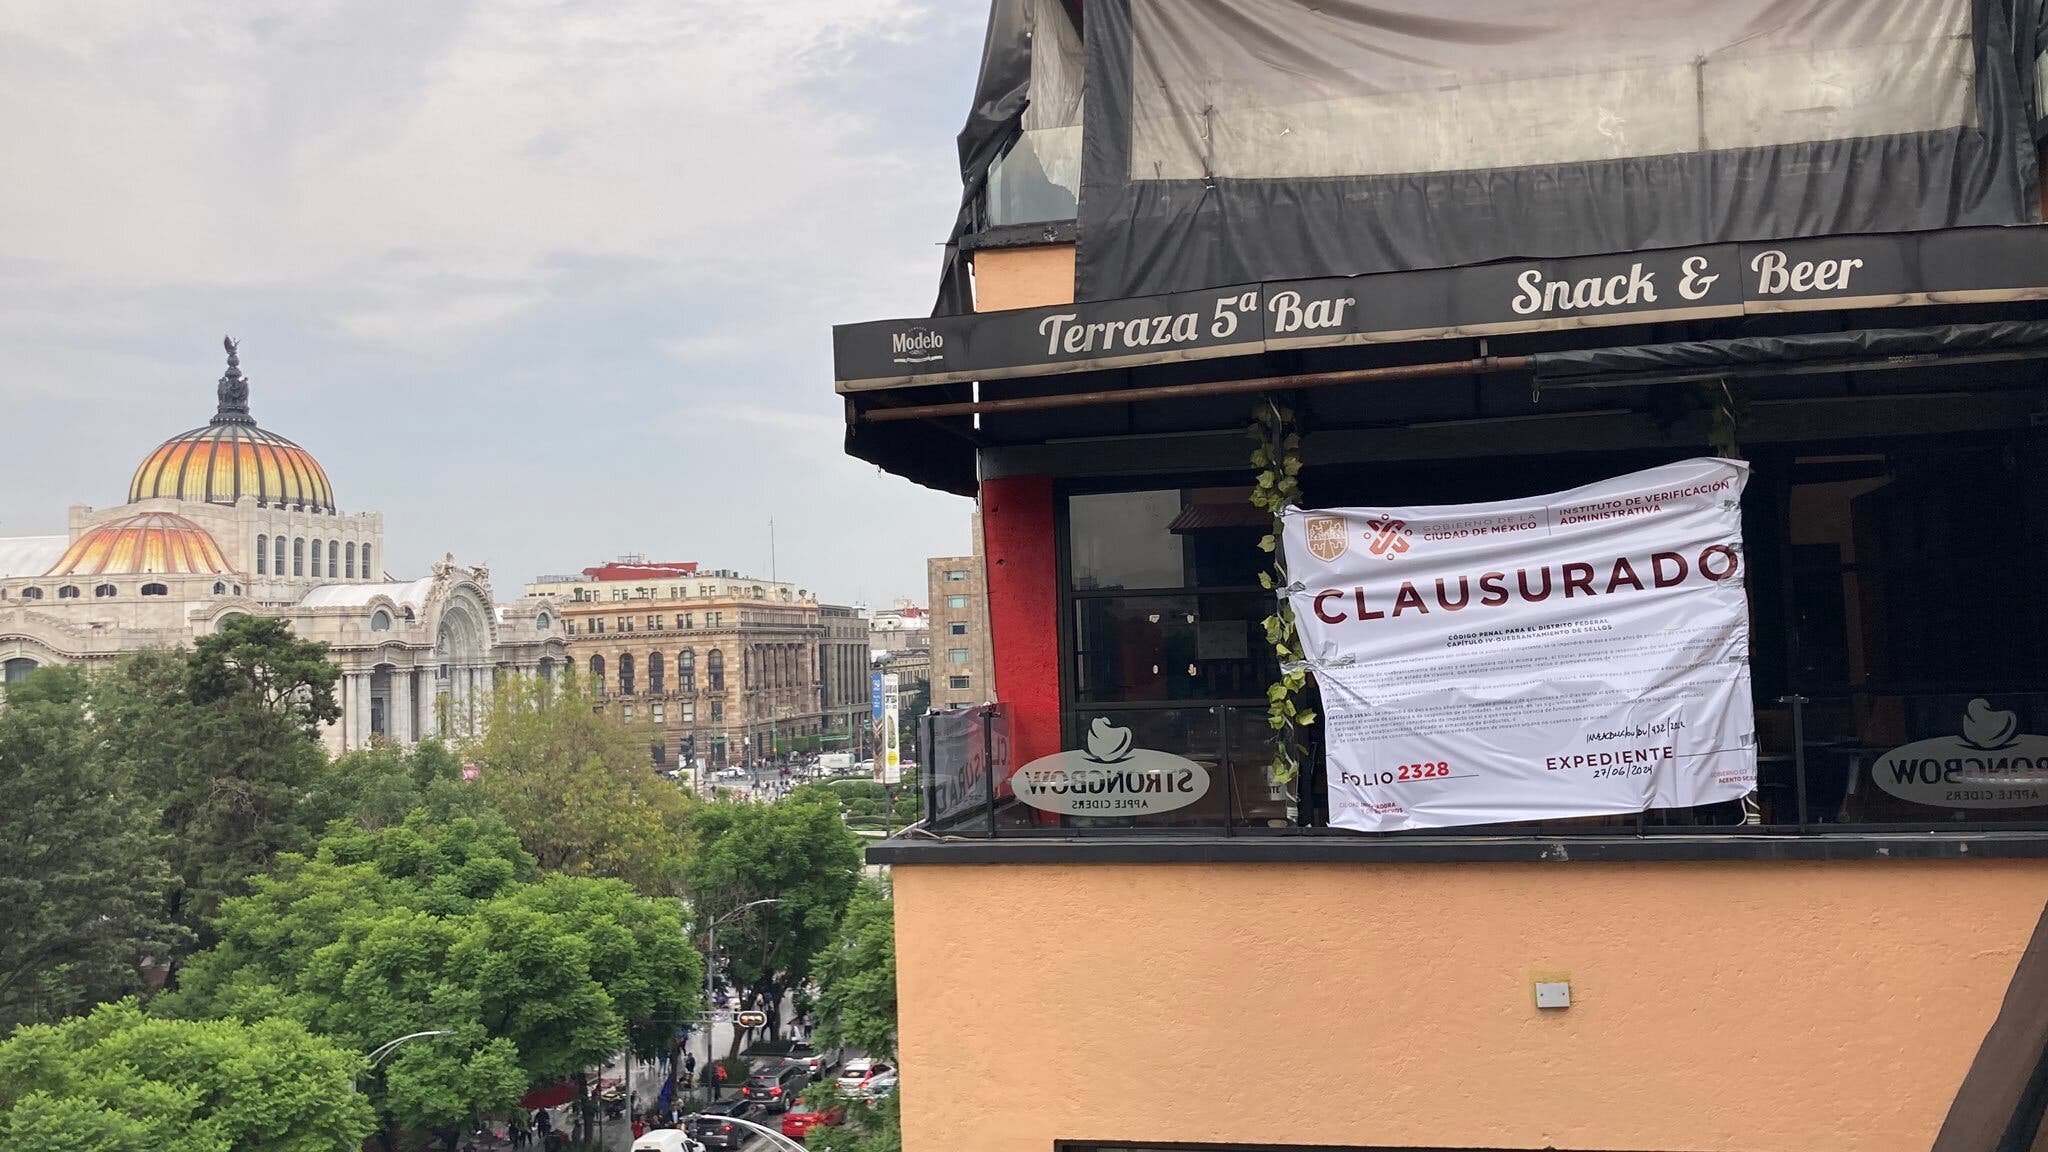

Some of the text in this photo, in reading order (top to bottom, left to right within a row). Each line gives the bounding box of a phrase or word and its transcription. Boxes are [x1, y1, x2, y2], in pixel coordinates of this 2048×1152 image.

[1511, 249, 1864, 314] Snack & Beer
[1038, 312, 1198, 355] Terraza
[1268, 290, 1356, 333] Bar
[892, 331, 944, 353] Modelo
[1559, 480, 1730, 516] INSTITUTO DE VERIFICACIÓN
[1423, 513, 1537, 532] GOBIERNO DE LA
[1560, 504, 1662, 526] ADMINISTRATIVA
[1423, 521, 1537, 542] CIUDAD DE MÉXICO
[1312, 544, 1739, 625] CLAUSURADO
[1446, 638, 1484, 648] CAPÍTULO
[1572, 627, 1583, 635] DE
[1584, 624, 1614, 632] SELLOS
[1447, 632, 1477, 641] CÓDIGO
[1479, 630, 1504, 638] PENAL
[1505, 627, 1526, 635] PARA
[1538, 621, 1573, 631] DISTRITO
[1574, 618, 1610, 627] FEDERAL
[1546, 746, 1674, 771] EXPEDIENTE
[1341, 761, 1450, 787] FOLIO 2328
[1592, 763, 1653, 779] 27/06/2024
[1718, 776, 1742, 784] ACENTO
